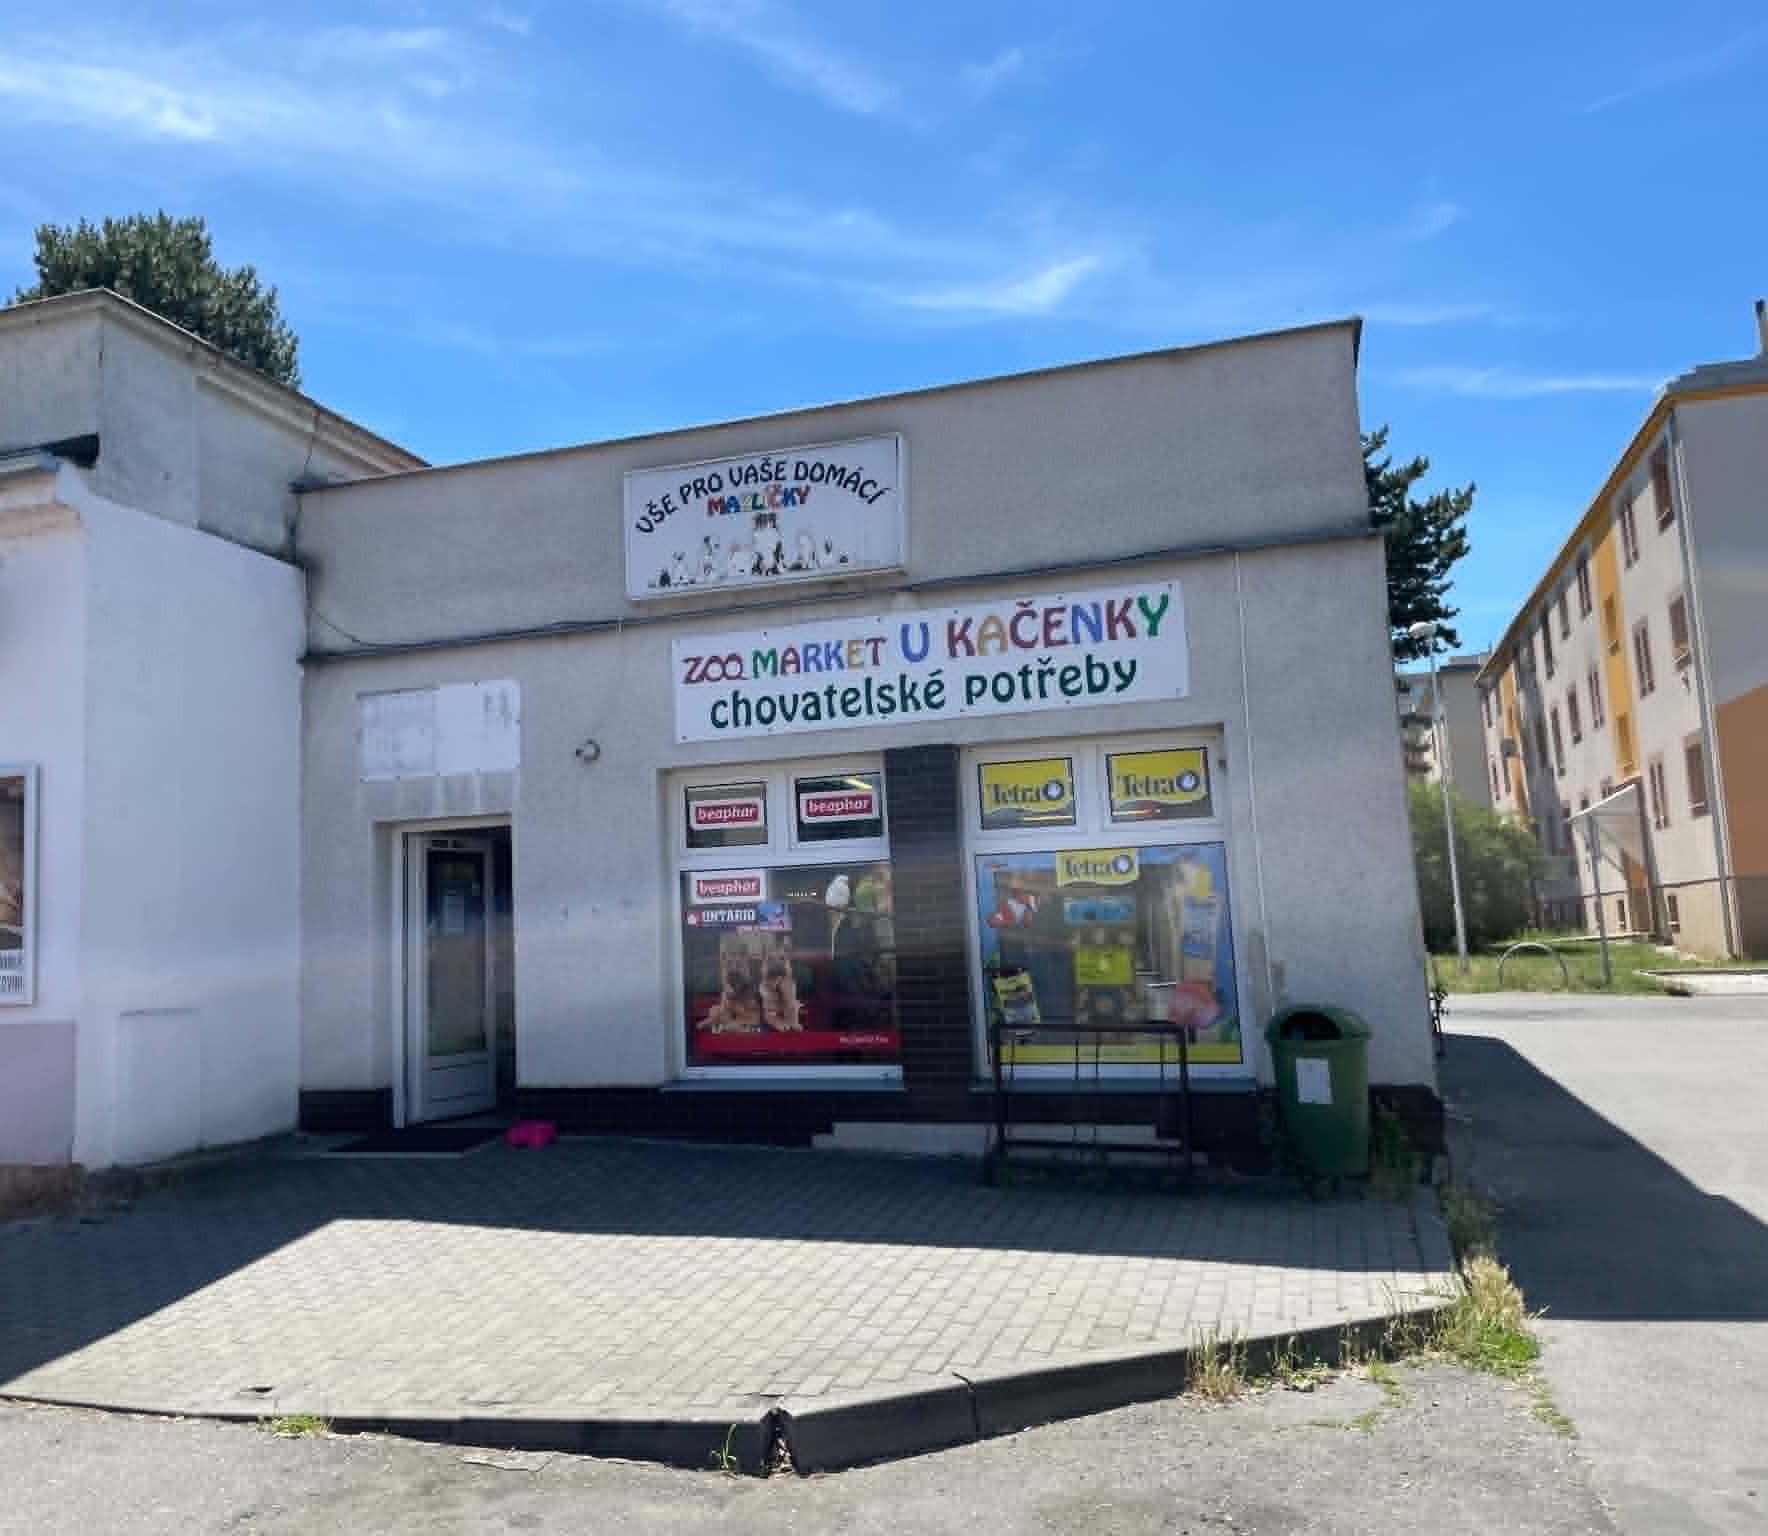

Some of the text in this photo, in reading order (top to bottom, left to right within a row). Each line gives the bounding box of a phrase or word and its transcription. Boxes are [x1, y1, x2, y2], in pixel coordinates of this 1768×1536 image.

[635, 457, 891, 534] VŠE PRO VAŠE DOMÁCÍ
[681, 593, 1170, 685] ZOO MARKET U KAČENKY
[710, 652, 1138, 729] chovatelské potřeby
